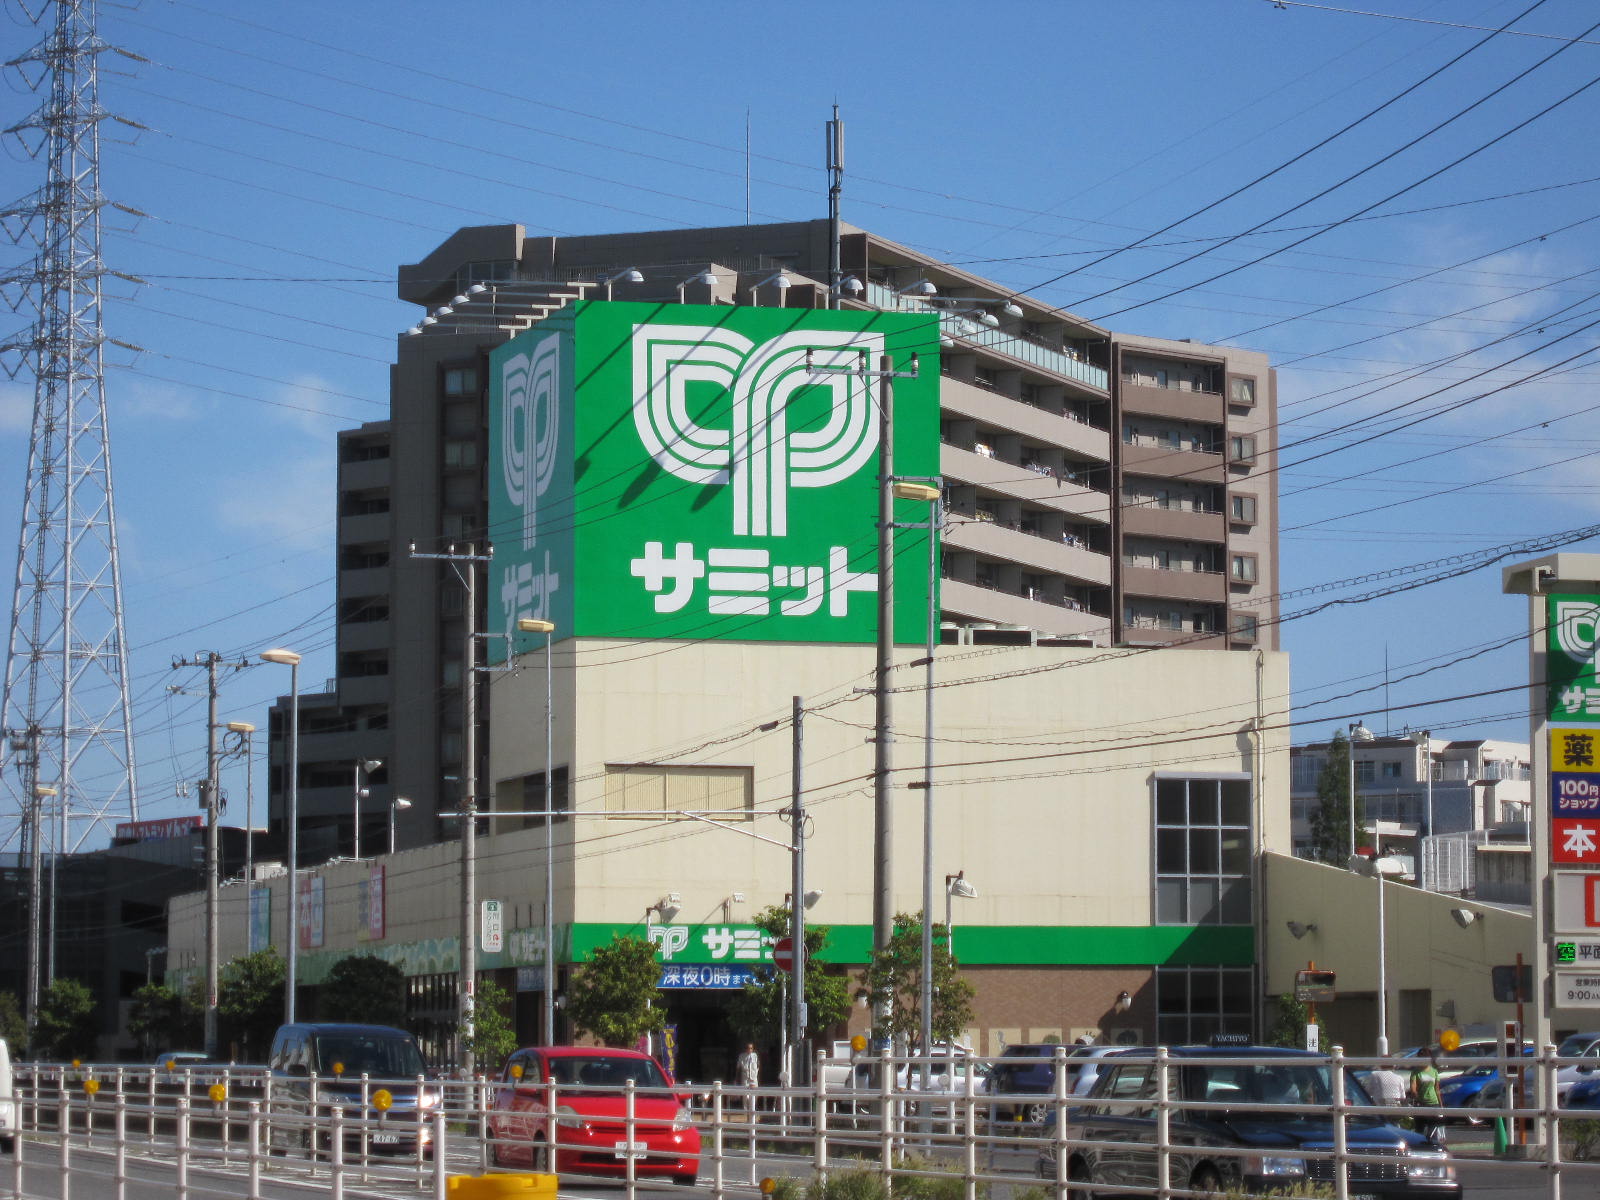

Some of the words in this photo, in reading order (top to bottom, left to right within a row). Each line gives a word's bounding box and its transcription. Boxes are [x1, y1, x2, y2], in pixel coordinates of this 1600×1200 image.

[502, 550, 559, 633] サミット
[630, 541, 879, 617] サミット
[1563, 733, 1594, 767] 薬
[1560, 780, 1599, 796] 100円
[1560, 797, 1599, 809] ショップ
[1563, 824, 1597, 858] 本
